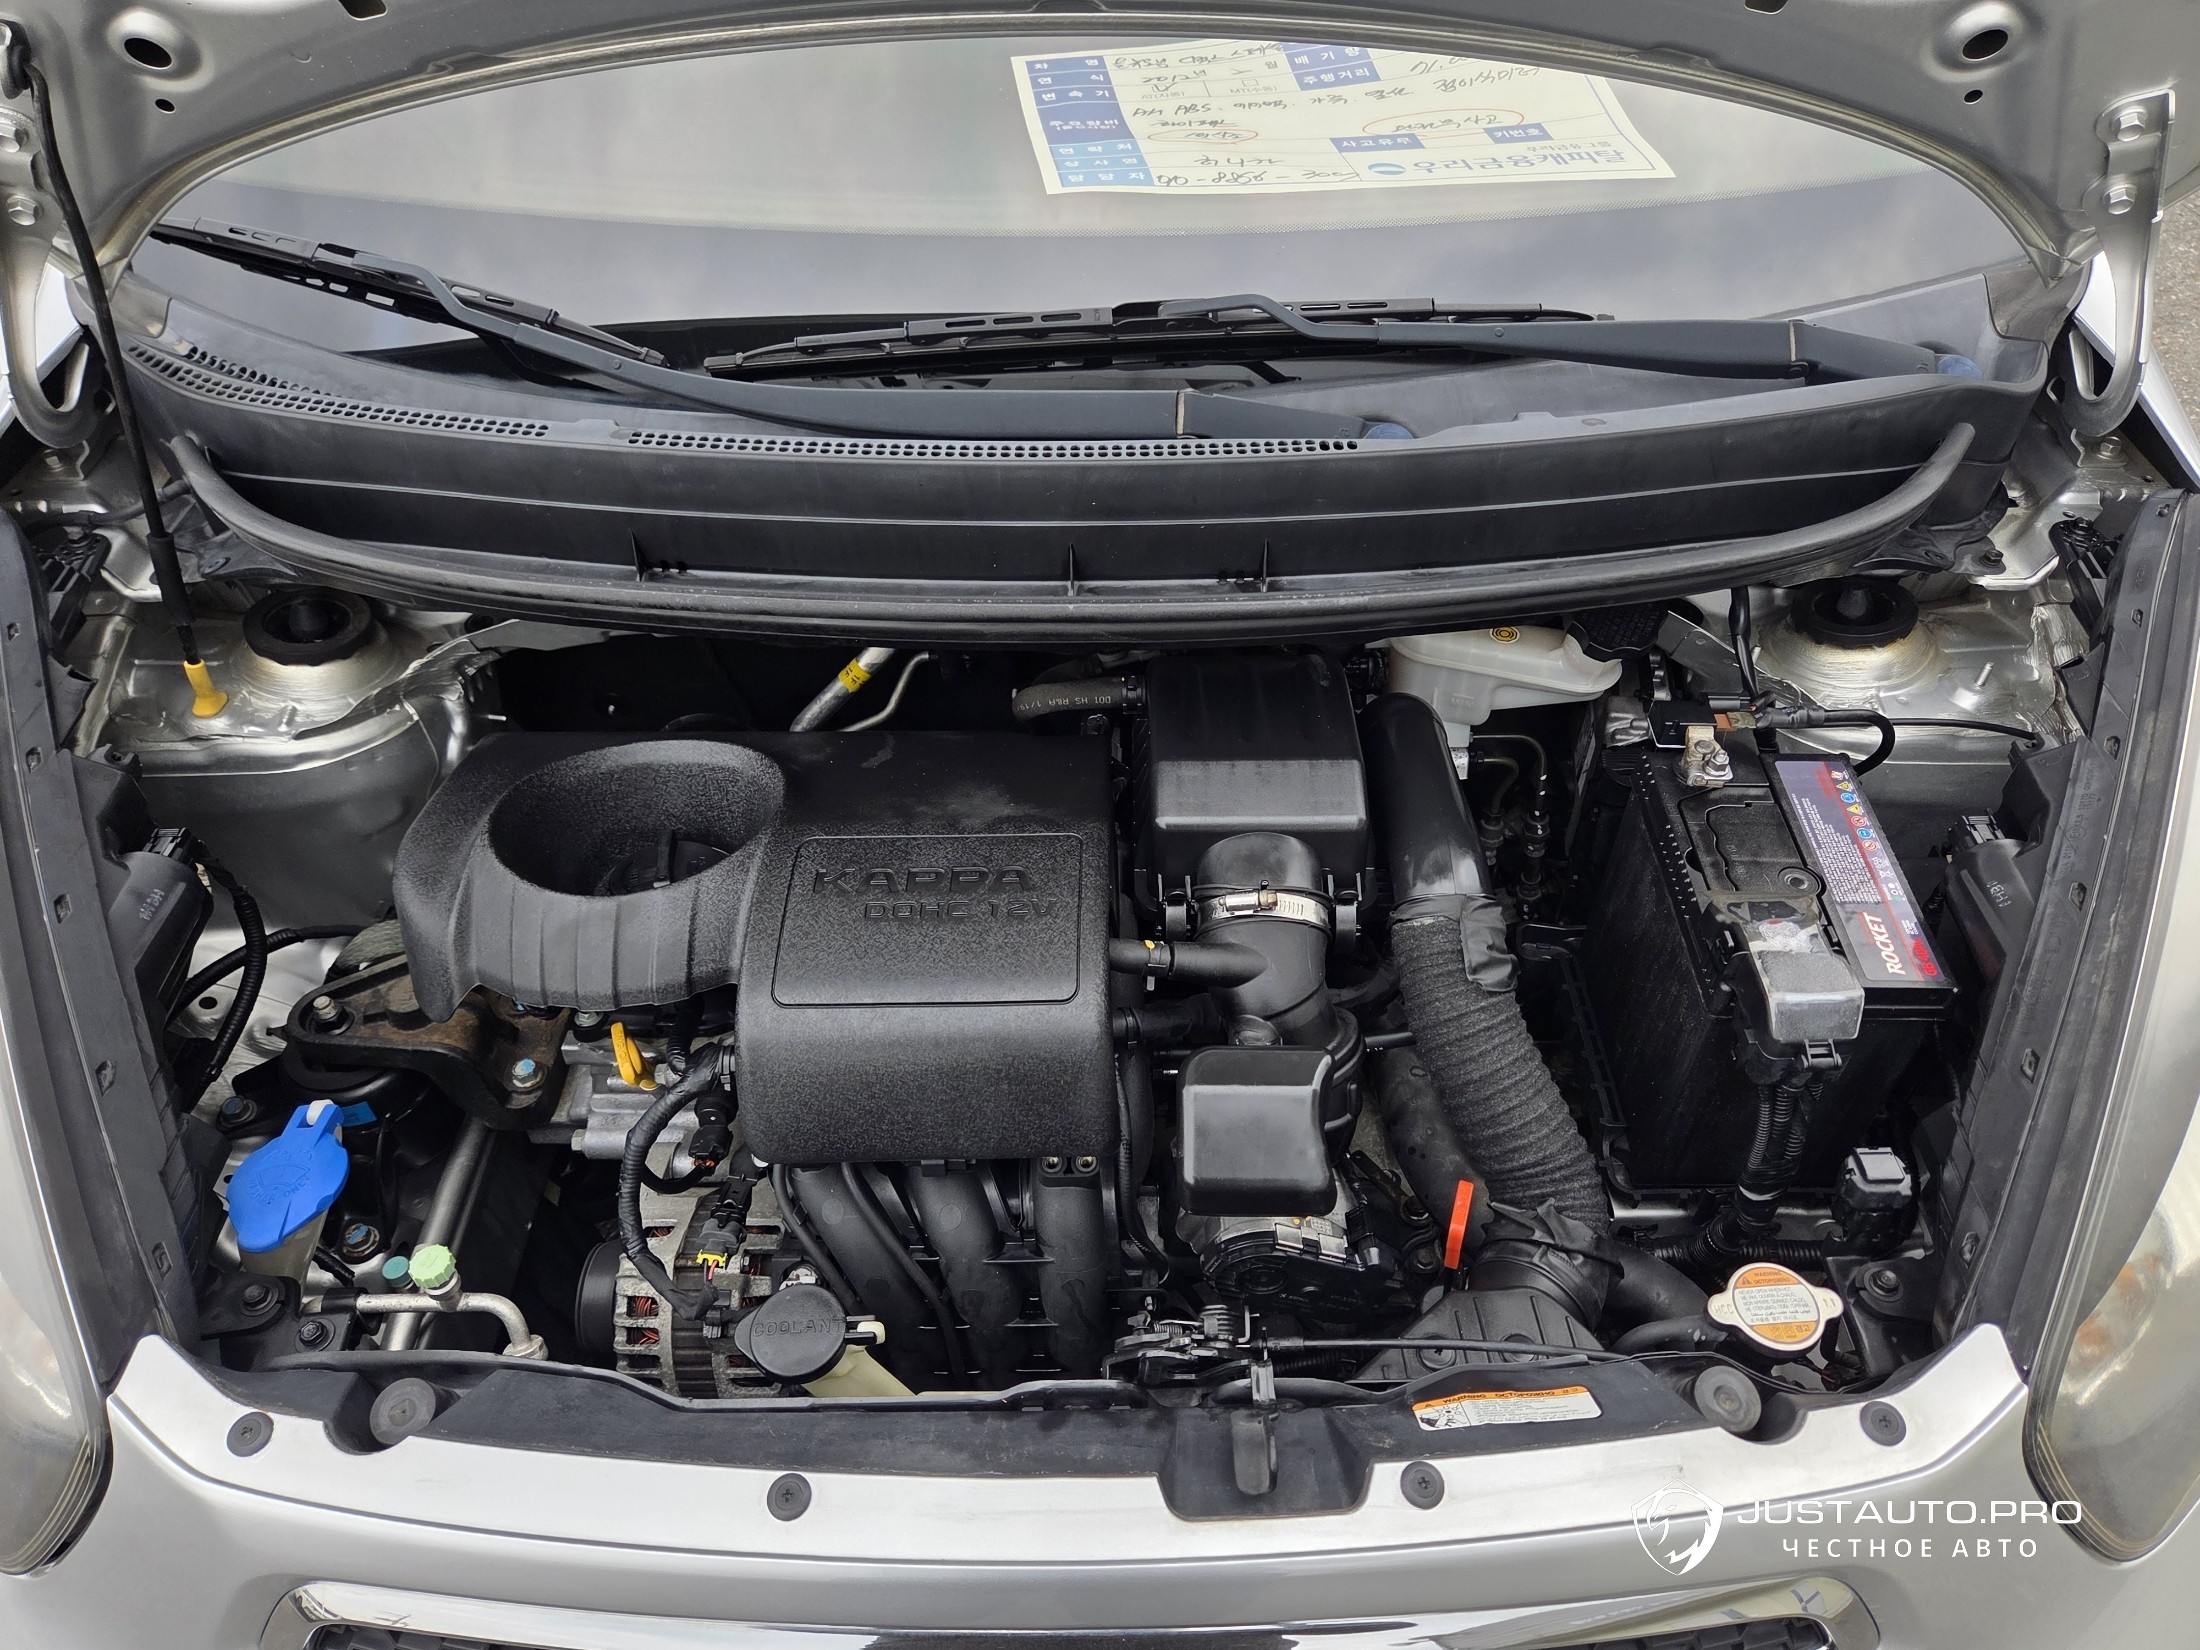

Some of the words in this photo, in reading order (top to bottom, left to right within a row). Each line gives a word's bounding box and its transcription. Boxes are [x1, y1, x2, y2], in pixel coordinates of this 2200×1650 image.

[1303, 67, 1370, 84] 주행거리
[1494, 127, 1544, 138] 키번호
[1413, 149, 1628, 174] 우리금융캐피탈
[813, 865, 1035, 895] KAPPA
[864, 900, 970, 920] DOHC
[990, 898, 1057, 919] 12V
[1862, 911, 1907, 975] ROCKET
[753, 1319, 846, 1338] COOLANT
[1442, 1393, 1488, 1405] WARNING
